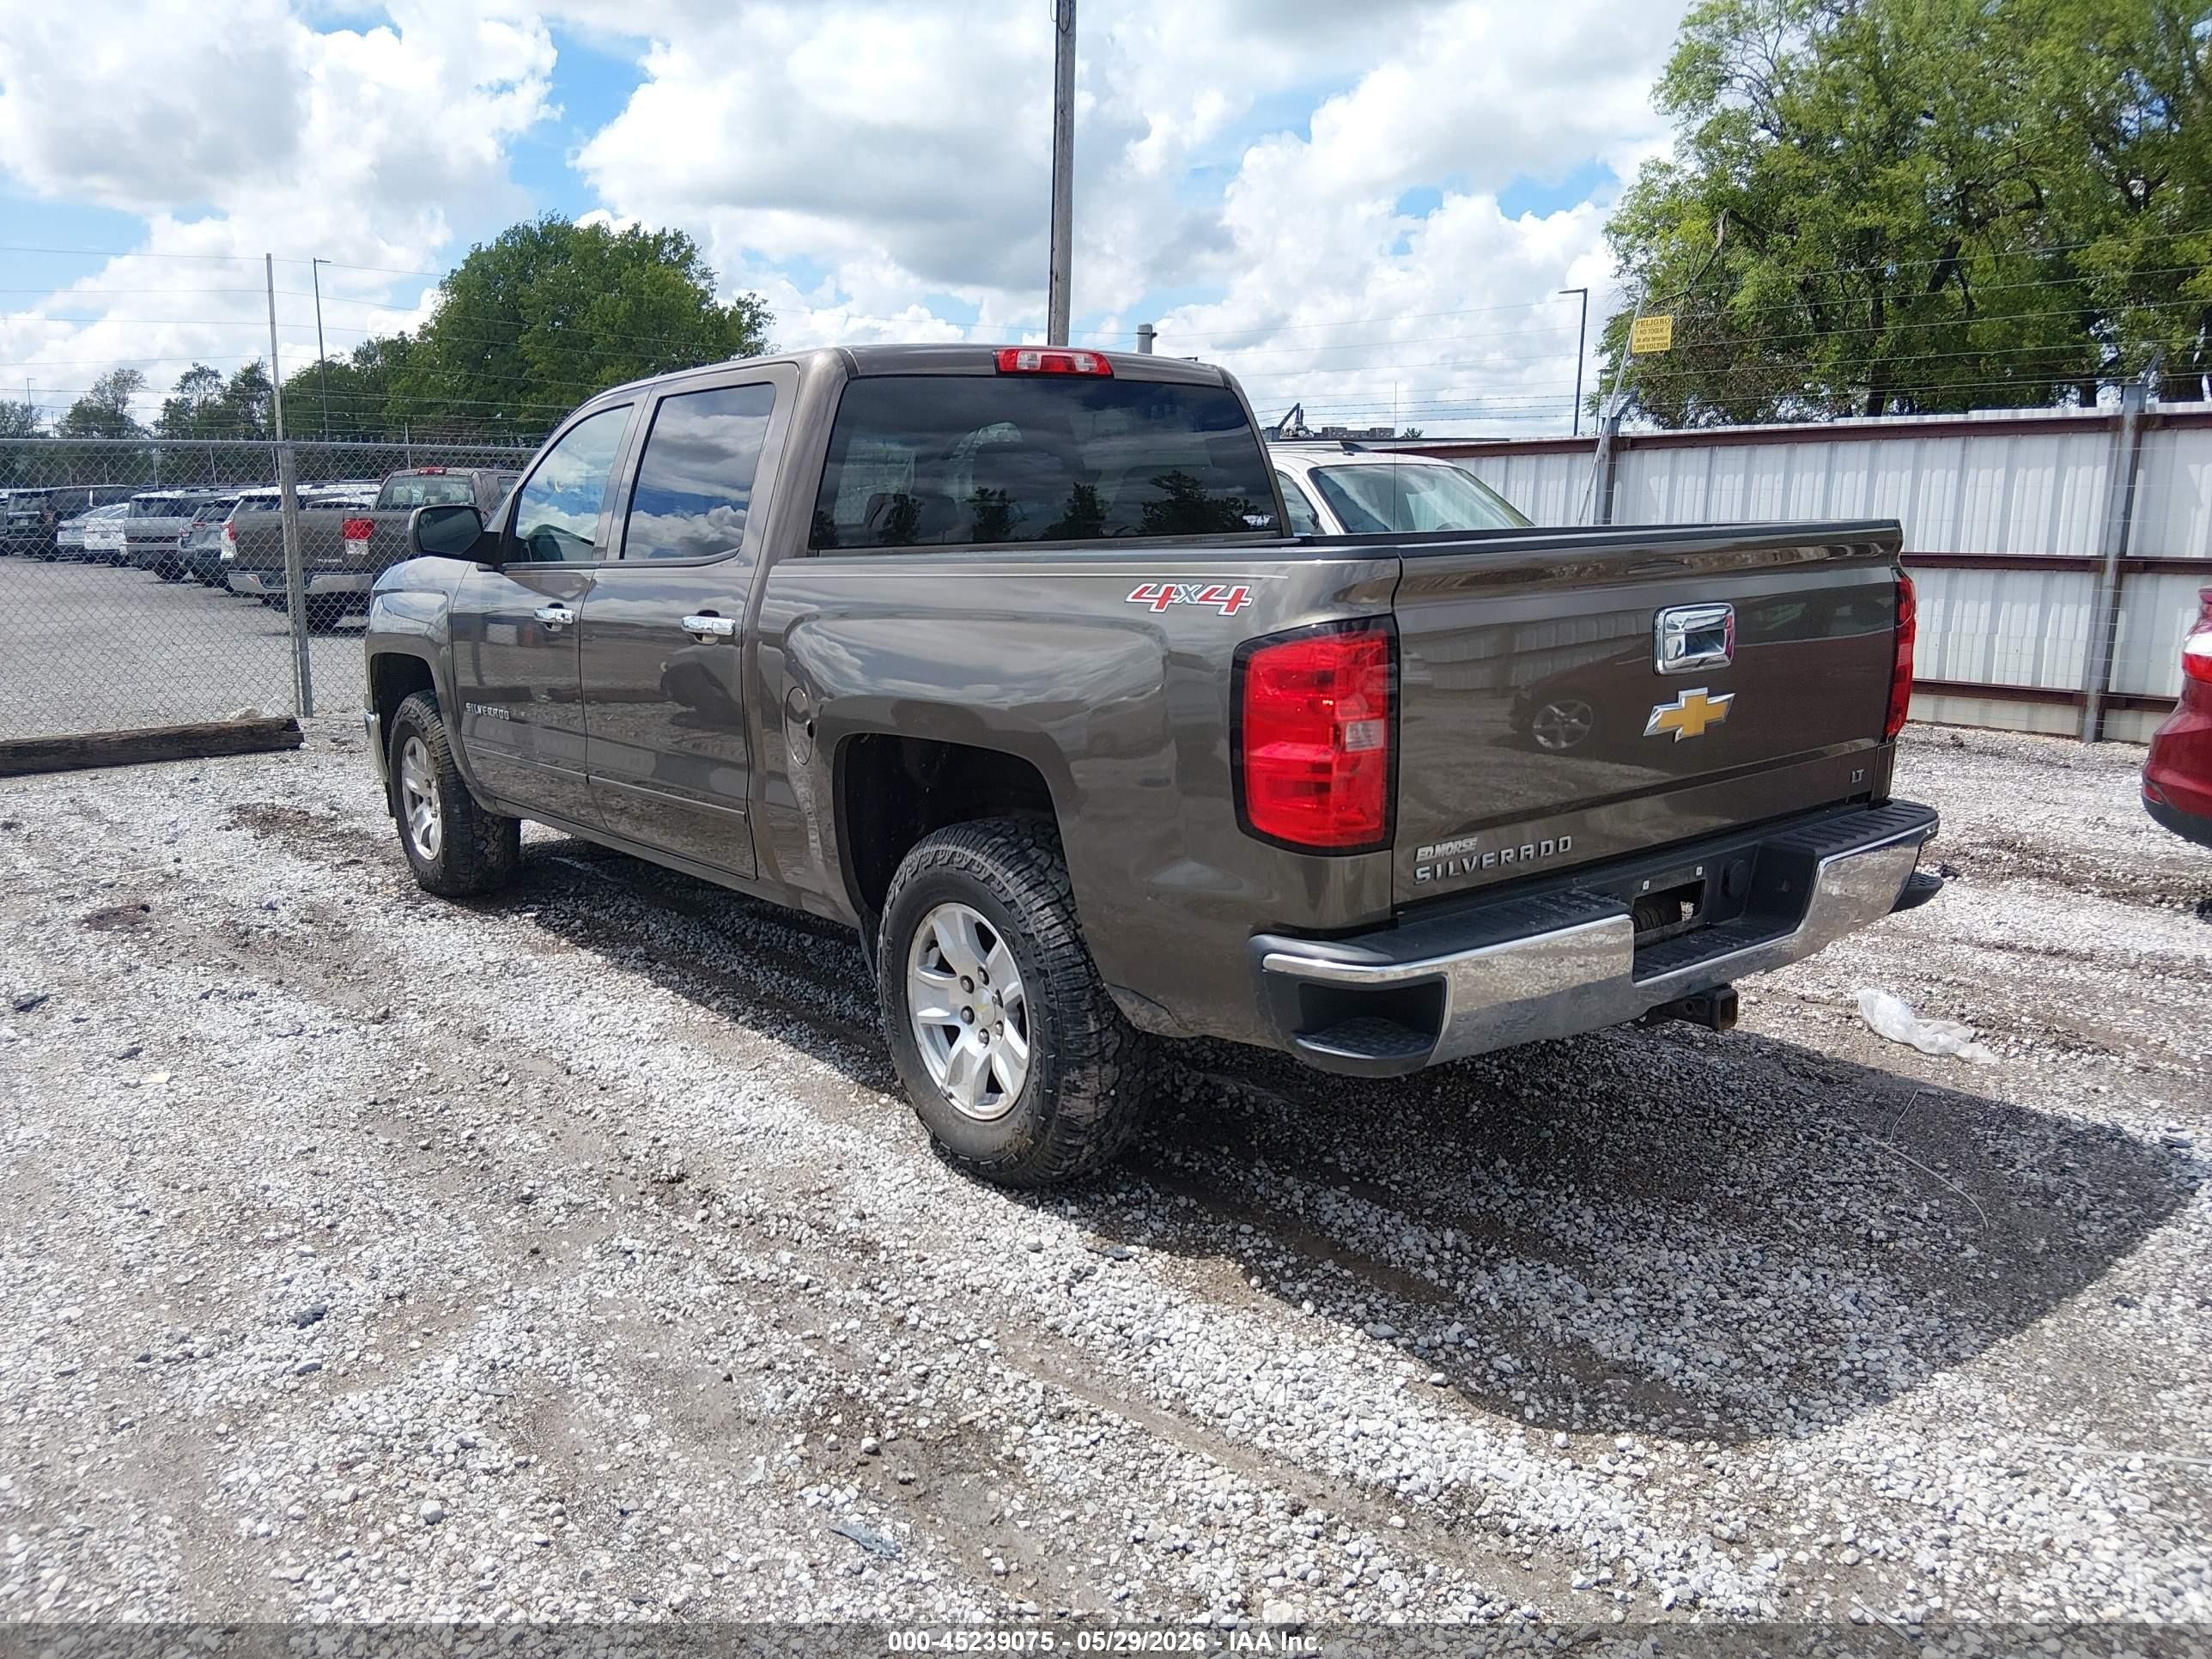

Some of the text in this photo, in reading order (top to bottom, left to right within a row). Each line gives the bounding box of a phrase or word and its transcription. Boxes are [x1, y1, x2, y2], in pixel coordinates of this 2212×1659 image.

[465, 702, 509, 720] SILVERADO
[1850, 769, 1864, 783] LT
[1414, 836, 1572, 885] SILVERADO
